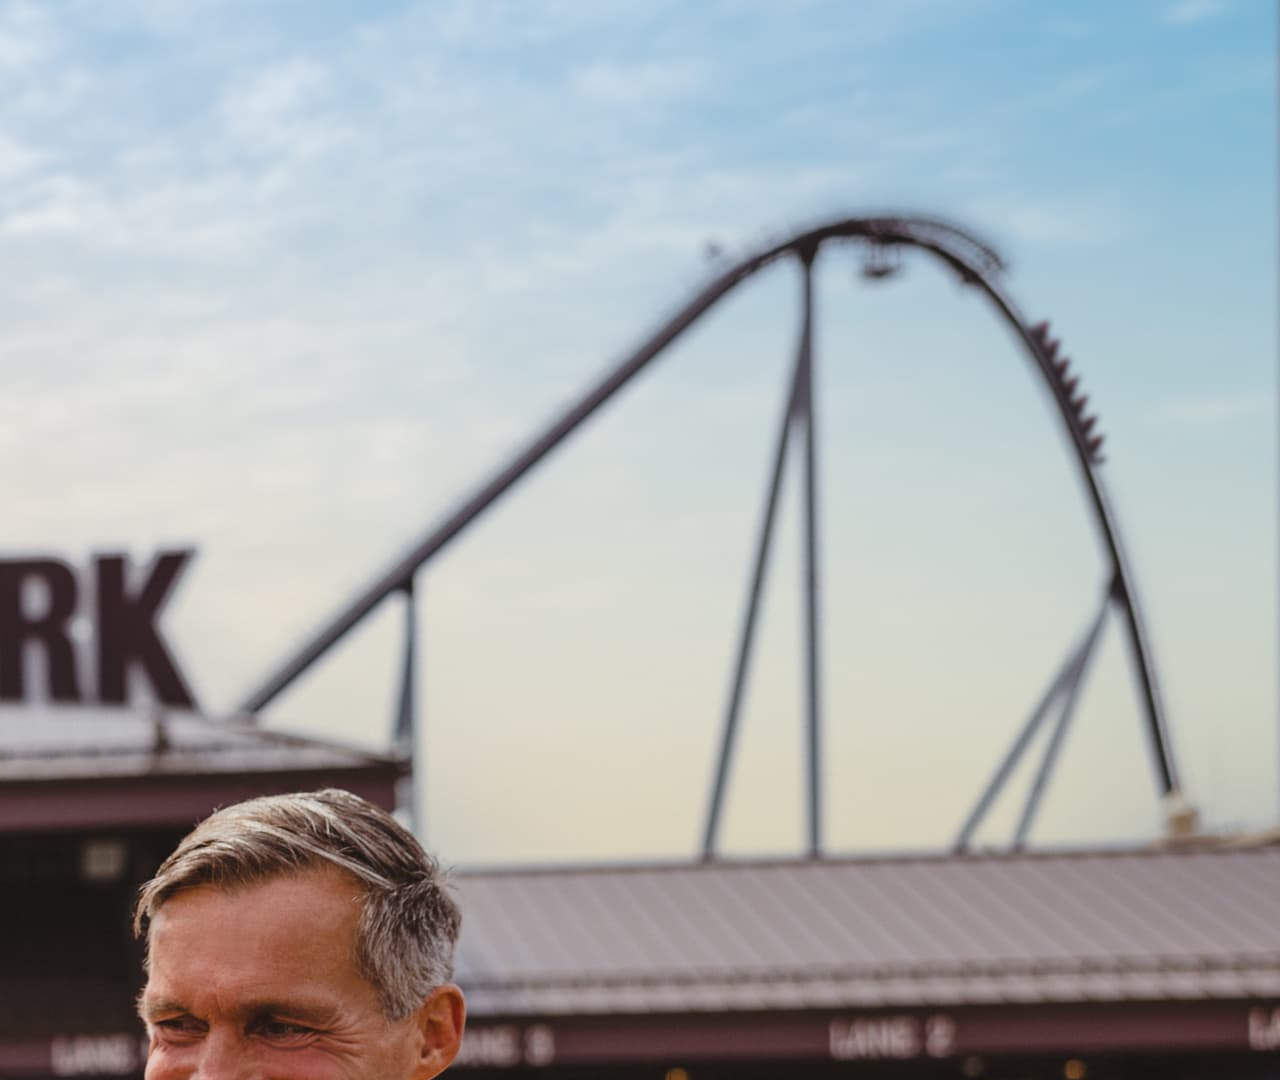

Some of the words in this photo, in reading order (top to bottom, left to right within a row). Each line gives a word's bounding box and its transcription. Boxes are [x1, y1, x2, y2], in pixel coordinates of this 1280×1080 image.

[51, 1035, 136, 1075] LANE
[454, 1027, 518, 1066] ANE
[829, 1018, 917, 1059] LANE
